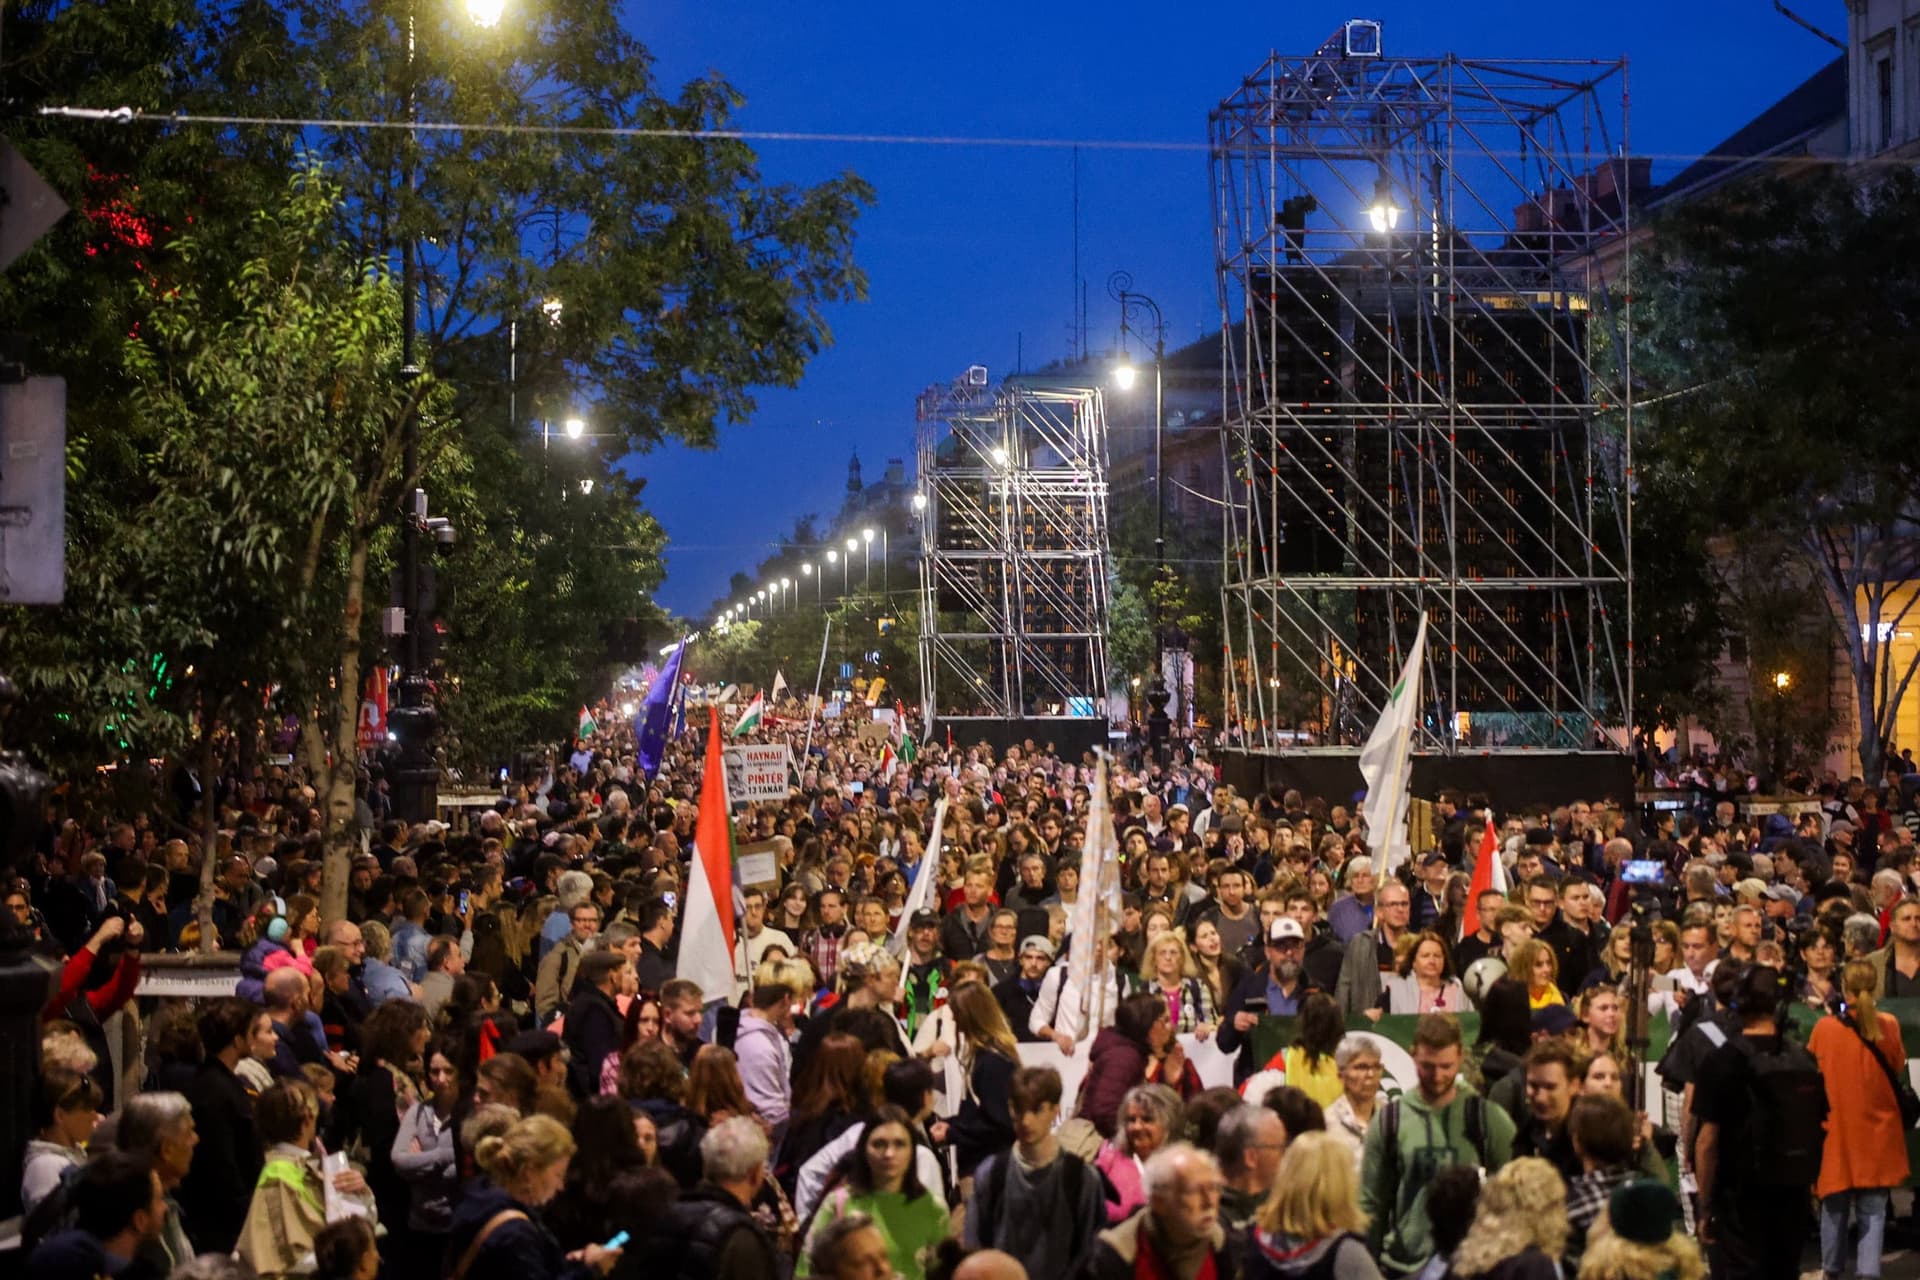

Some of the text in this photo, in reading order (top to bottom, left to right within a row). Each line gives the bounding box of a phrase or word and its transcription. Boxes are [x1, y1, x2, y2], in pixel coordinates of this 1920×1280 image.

[746, 752, 782, 761] HAYNAU
[748, 771, 783, 785] PINTÉR
[748, 786, 757, 795] 13
